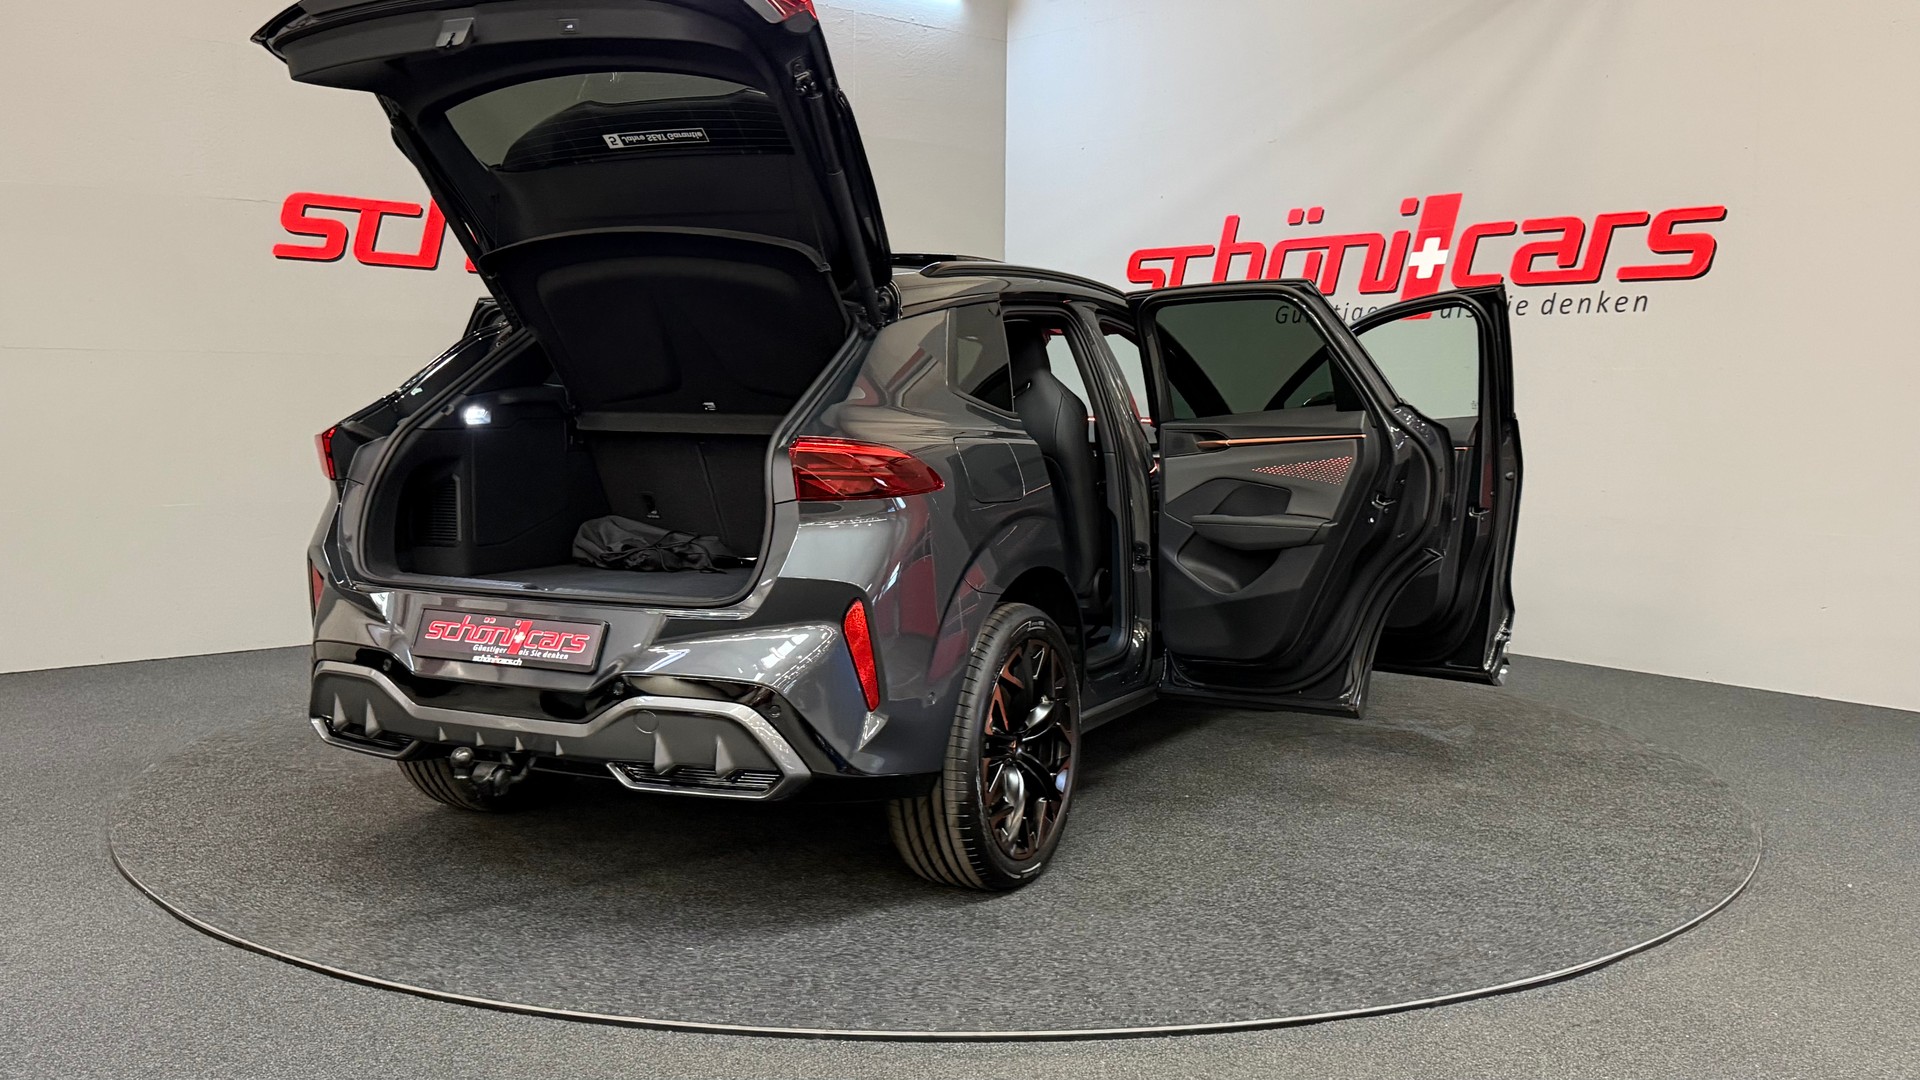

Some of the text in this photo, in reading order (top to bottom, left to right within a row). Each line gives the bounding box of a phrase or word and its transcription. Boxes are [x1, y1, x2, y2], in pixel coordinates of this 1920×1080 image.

[1541, 290, 1649, 316] denken
[472, 644, 569, 660] Günstiger als Sie denken
